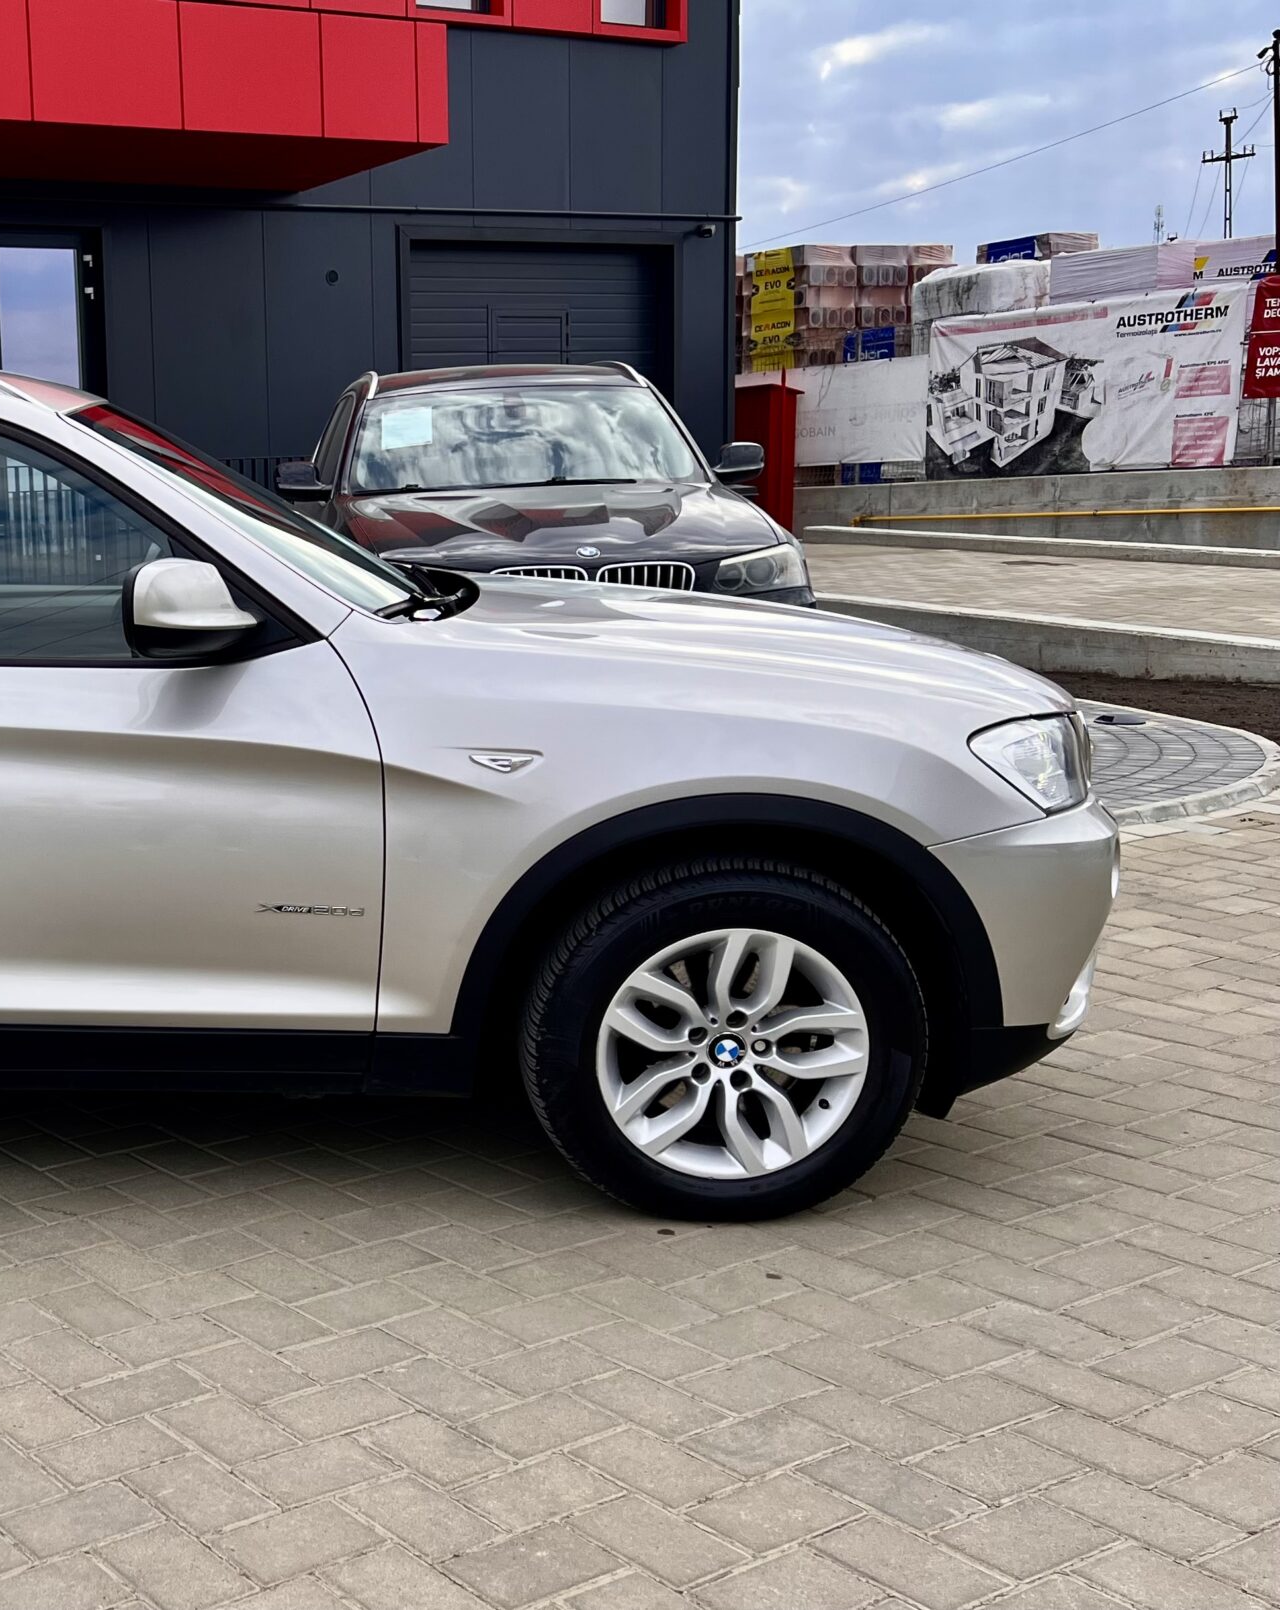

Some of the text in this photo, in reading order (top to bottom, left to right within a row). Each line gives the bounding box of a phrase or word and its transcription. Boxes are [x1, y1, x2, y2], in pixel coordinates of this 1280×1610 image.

[764, 279, 782, 291] EVO
[1116, 305, 1230, 329] AUSTROTHERM
[762, 334, 780, 345] EVO
[1256, 356, 1280, 367] LAVA
[797, 425, 836, 439] OBAIN
